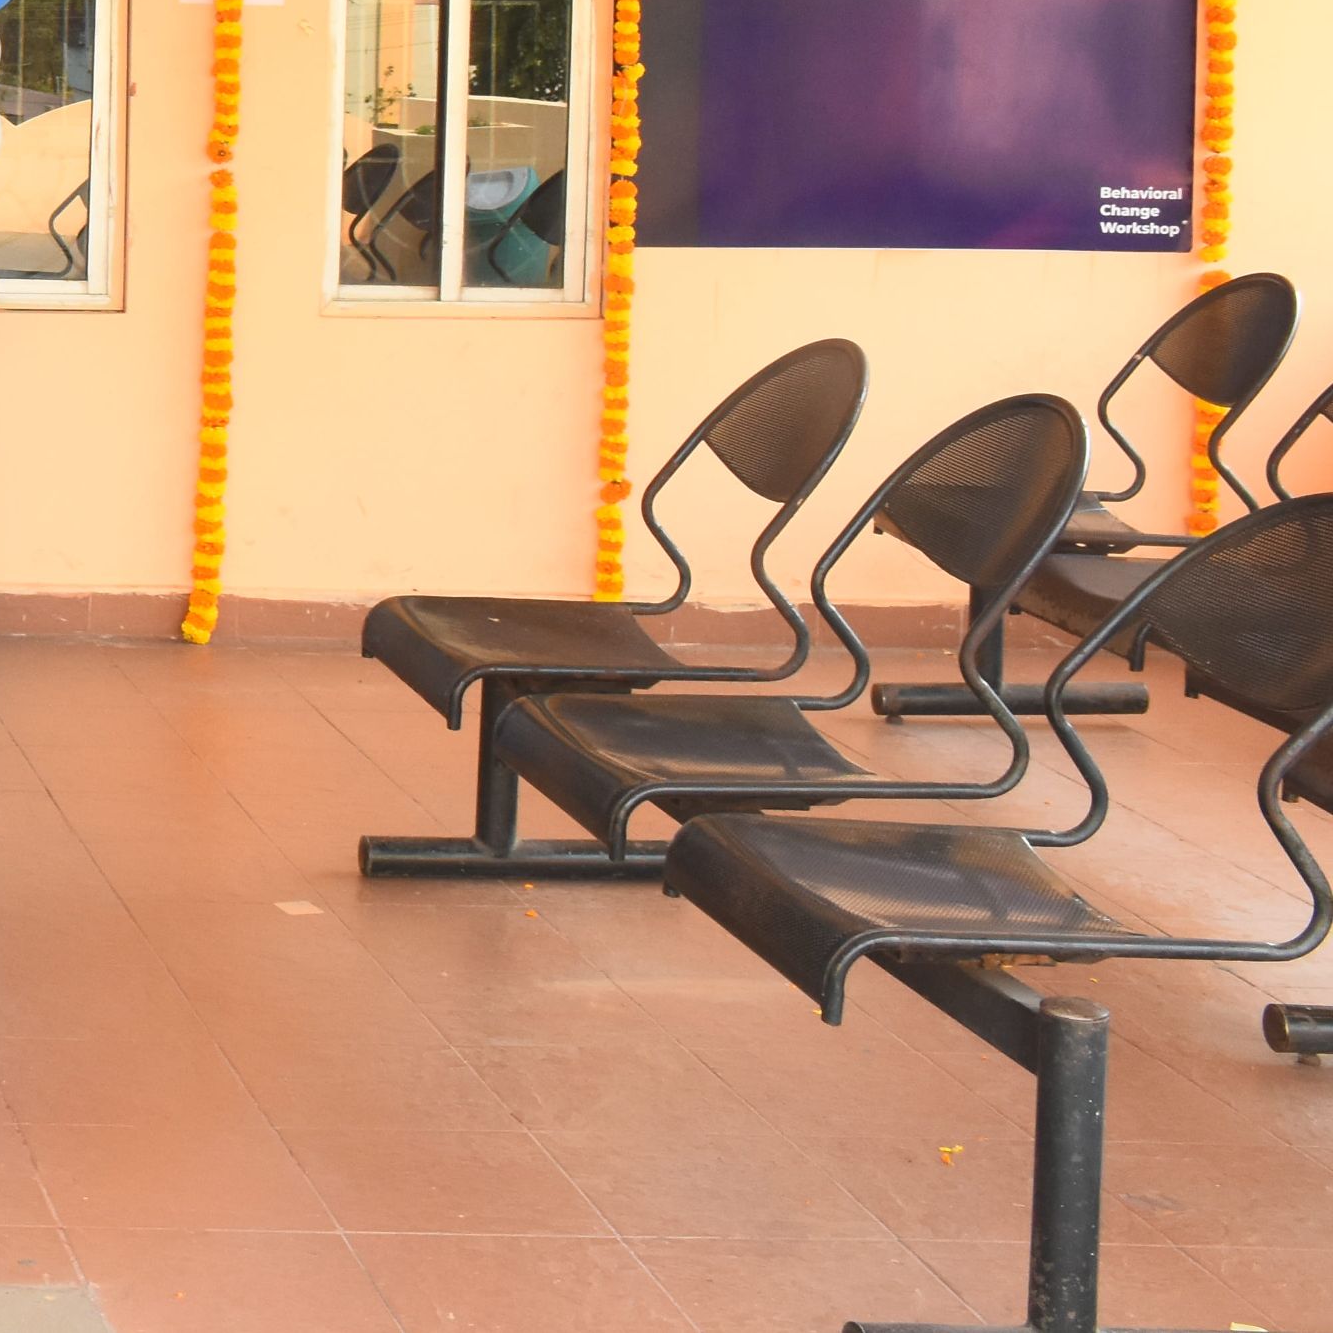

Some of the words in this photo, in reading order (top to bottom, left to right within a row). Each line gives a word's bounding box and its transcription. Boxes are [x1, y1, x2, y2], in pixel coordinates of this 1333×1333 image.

[1100, 186, 1183, 200] Behavioral
[1100, 204, 1160, 220] Change
[1099, 222, 1180, 238] Workshop
